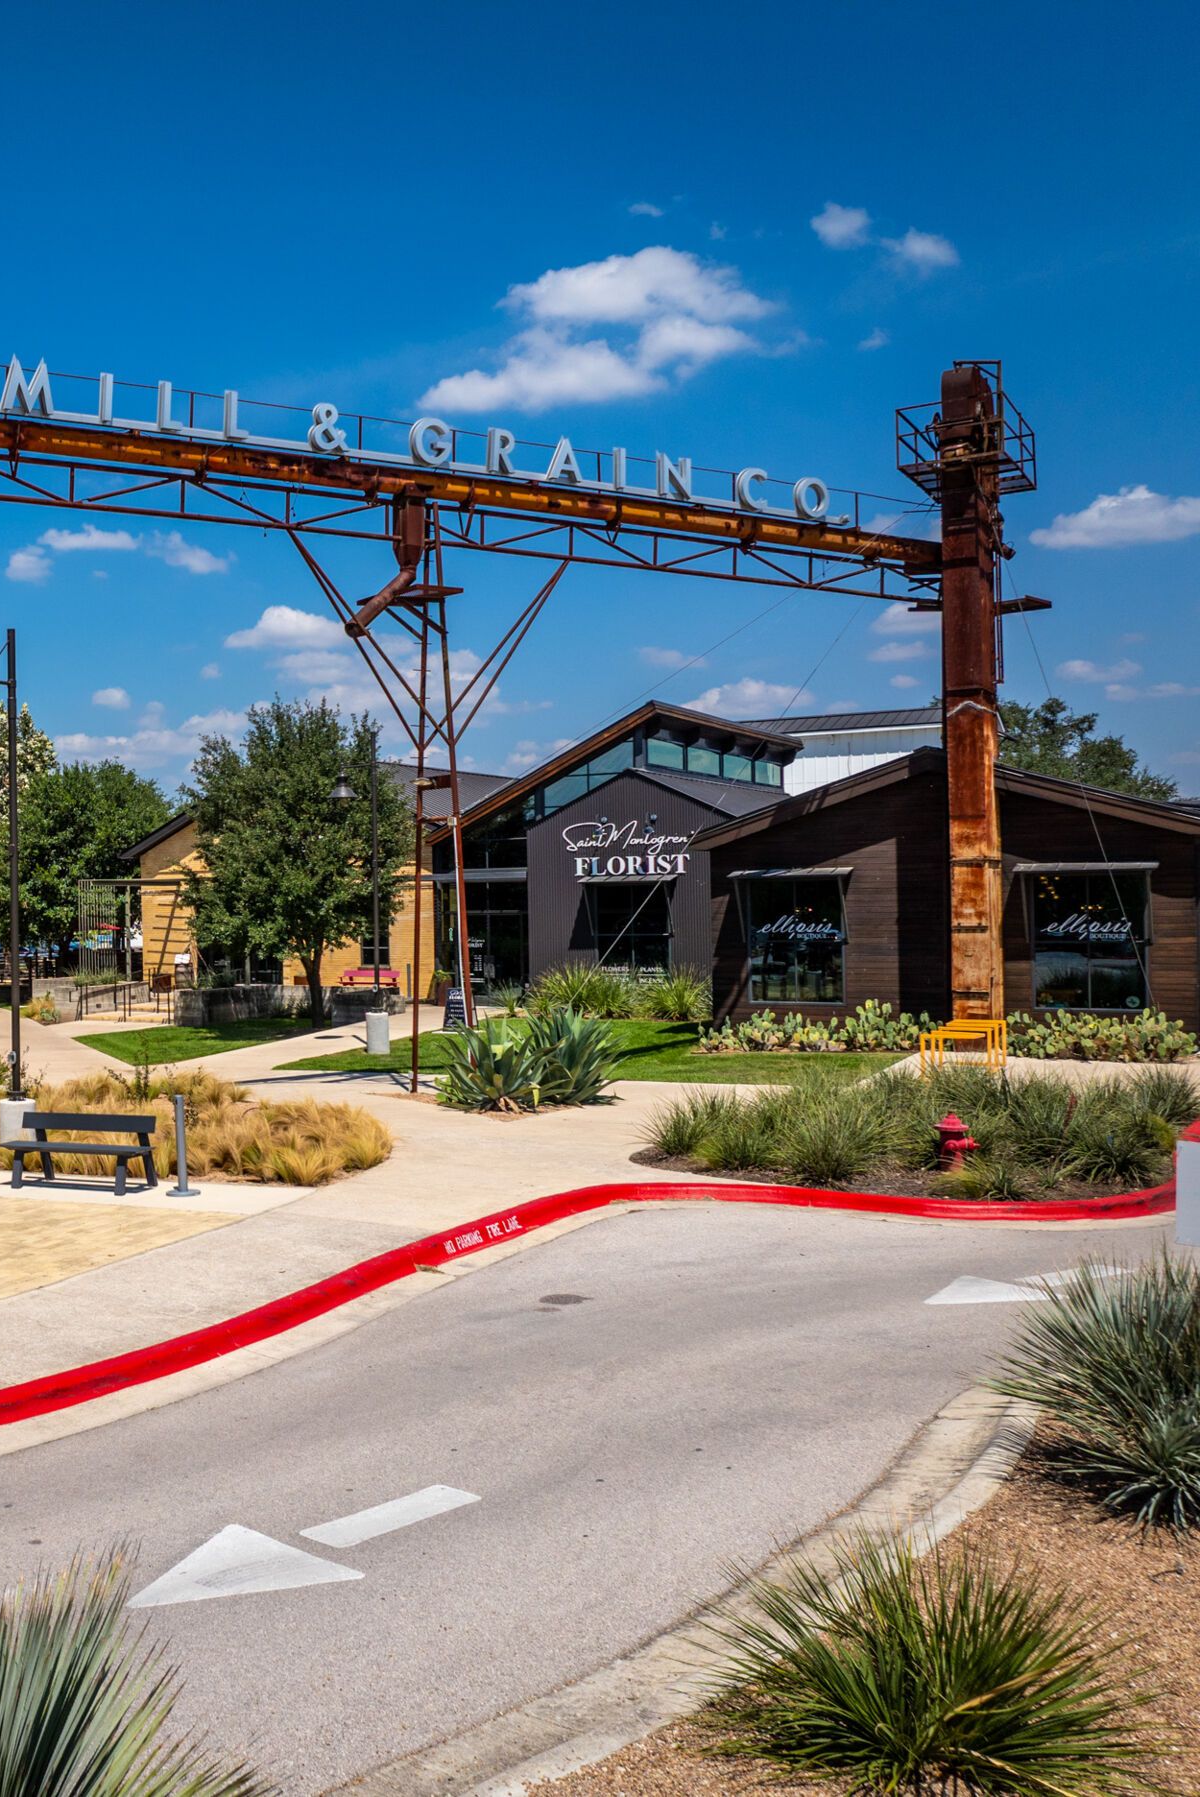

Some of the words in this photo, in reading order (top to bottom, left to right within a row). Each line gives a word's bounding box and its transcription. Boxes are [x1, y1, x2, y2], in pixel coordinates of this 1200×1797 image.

[1, 353, 249, 440] MILL
[307, 402, 349, 453] &
[409, 417, 693, 501] GRAIN
[562, 821, 607, 851] Saint
[574, 853, 690, 877] FLORIST
[443, 1240, 456, 1254] NO
[455, 1230, 484, 1250] PARKING
[486, 1222, 504, 1239] FIRE
[502, 1216, 523, 1232] LANE
